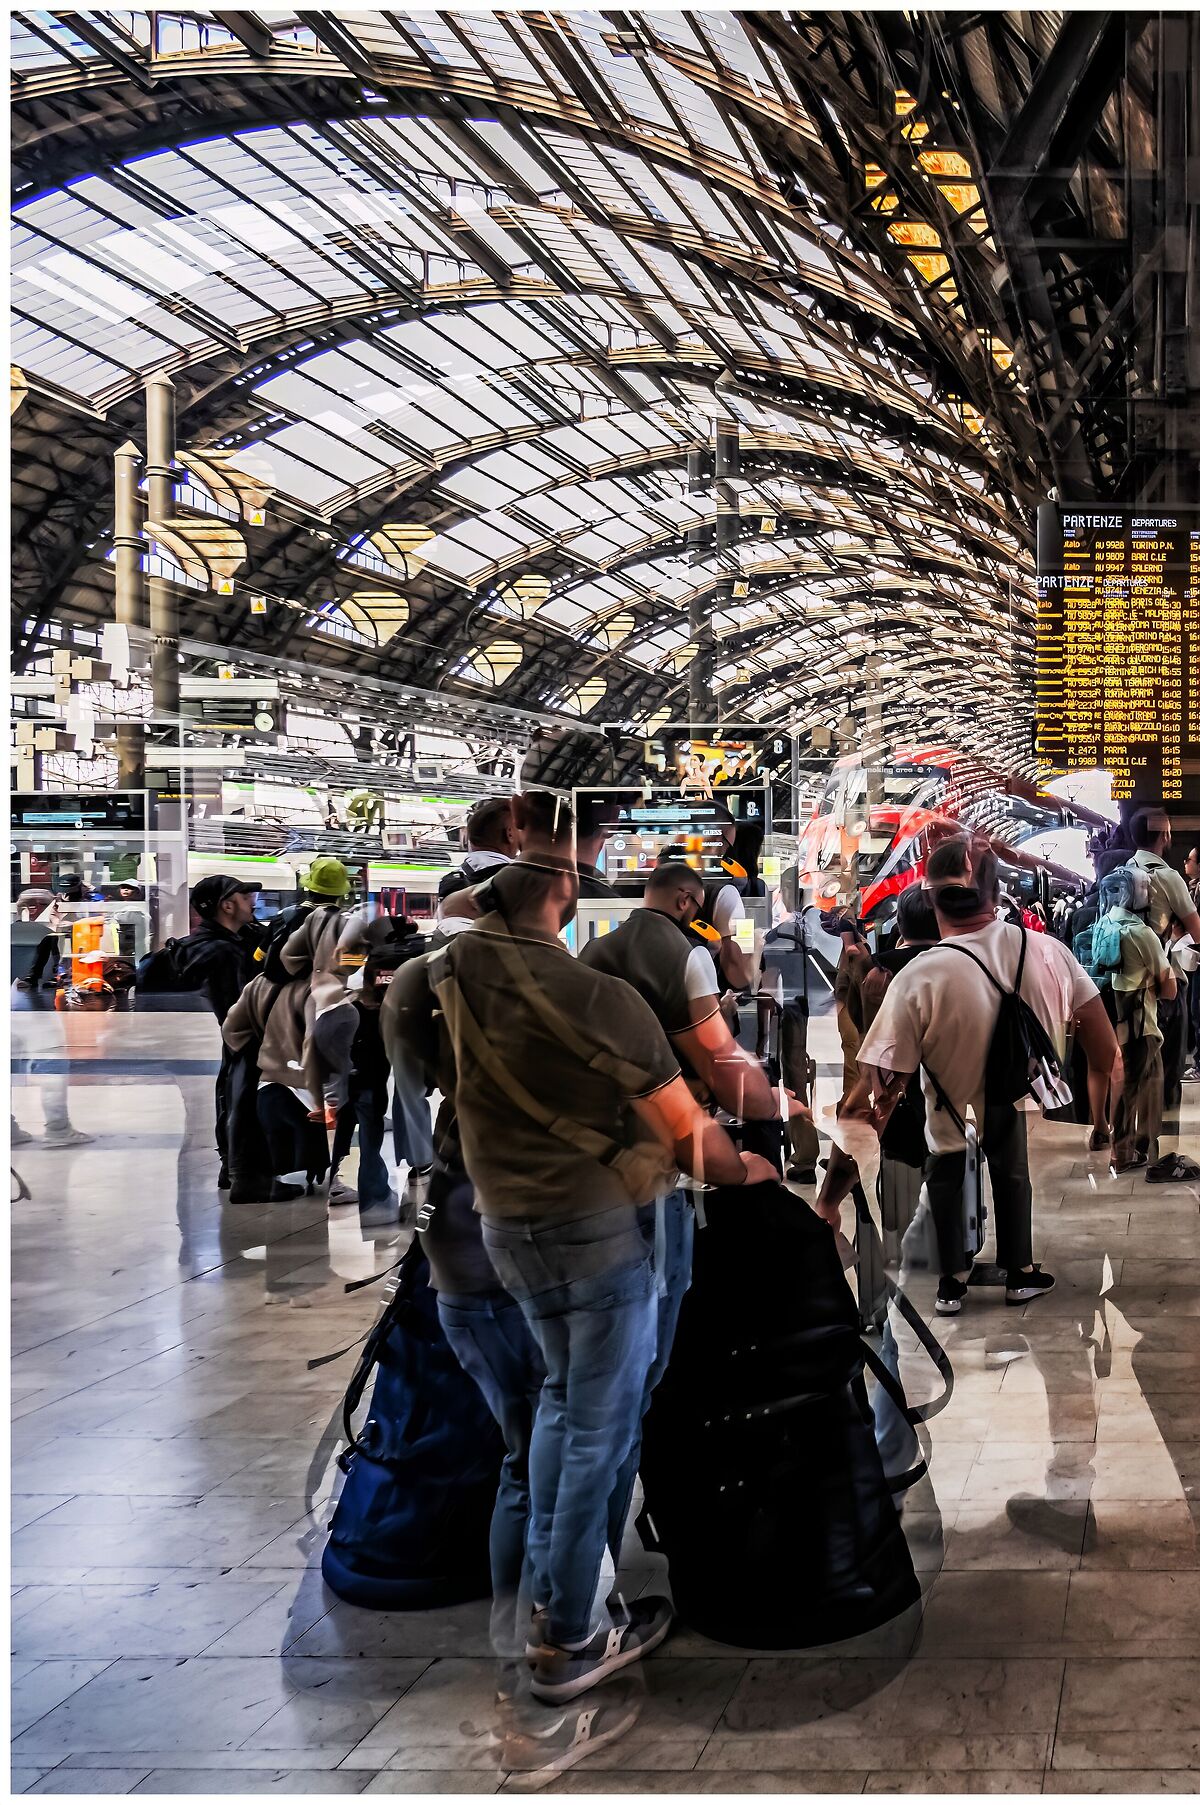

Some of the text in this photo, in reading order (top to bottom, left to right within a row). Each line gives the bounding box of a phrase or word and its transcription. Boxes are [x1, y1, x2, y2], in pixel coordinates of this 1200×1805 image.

[1063, 515, 1123, 528] PARTENZE
[1131, 518, 1177, 528] DEPARTURES
[1106, 541, 1125, 550] 9928
[1132, 541, 1158, 550] TORINO
[1160, 541, 1175, 550] P.N.
[1106, 552, 1125, 560] 9809
[1132, 553, 1148, 562] BARI
[1150, 553, 1167, 562] C.LE
[1106, 564, 1125, 572] 9947
[1132, 564, 1163, 572] SALERNO
[1036, 576, 1094, 588] PARTENZE
[1131, 587, 1162, 595] VENEZIA
[1162, 646, 1182, 654] 15:45
[1162, 679, 1182, 688] 16:00
[1162, 690, 1182, 698] 16:02
[1162, 712, 1182, 721] 16:05
[1162, 724, 1180, 732] 16:10
[1162, 735, 1180, 743] 16:10
[773, 739, 783, 754] 8
[1104, 746, 1128, 754] PARMA
[1162, 746, 1180, 754] 16:15
[1078, 758, 1097, 766] 9989
[1104, 758, 1130, 766] NAPOLI
[1131, 758, 1148, 766] C.LE
[1162, 758, 1180, 766] 16:15
[866, 766, 894, 774] moking
[1162, 769, 1182, 777] 16:20
[1162, 780, 1182, 788] 16:20
[1162, 791, 1182, 799] 16:25
[746, 801, 756, 817] 8
